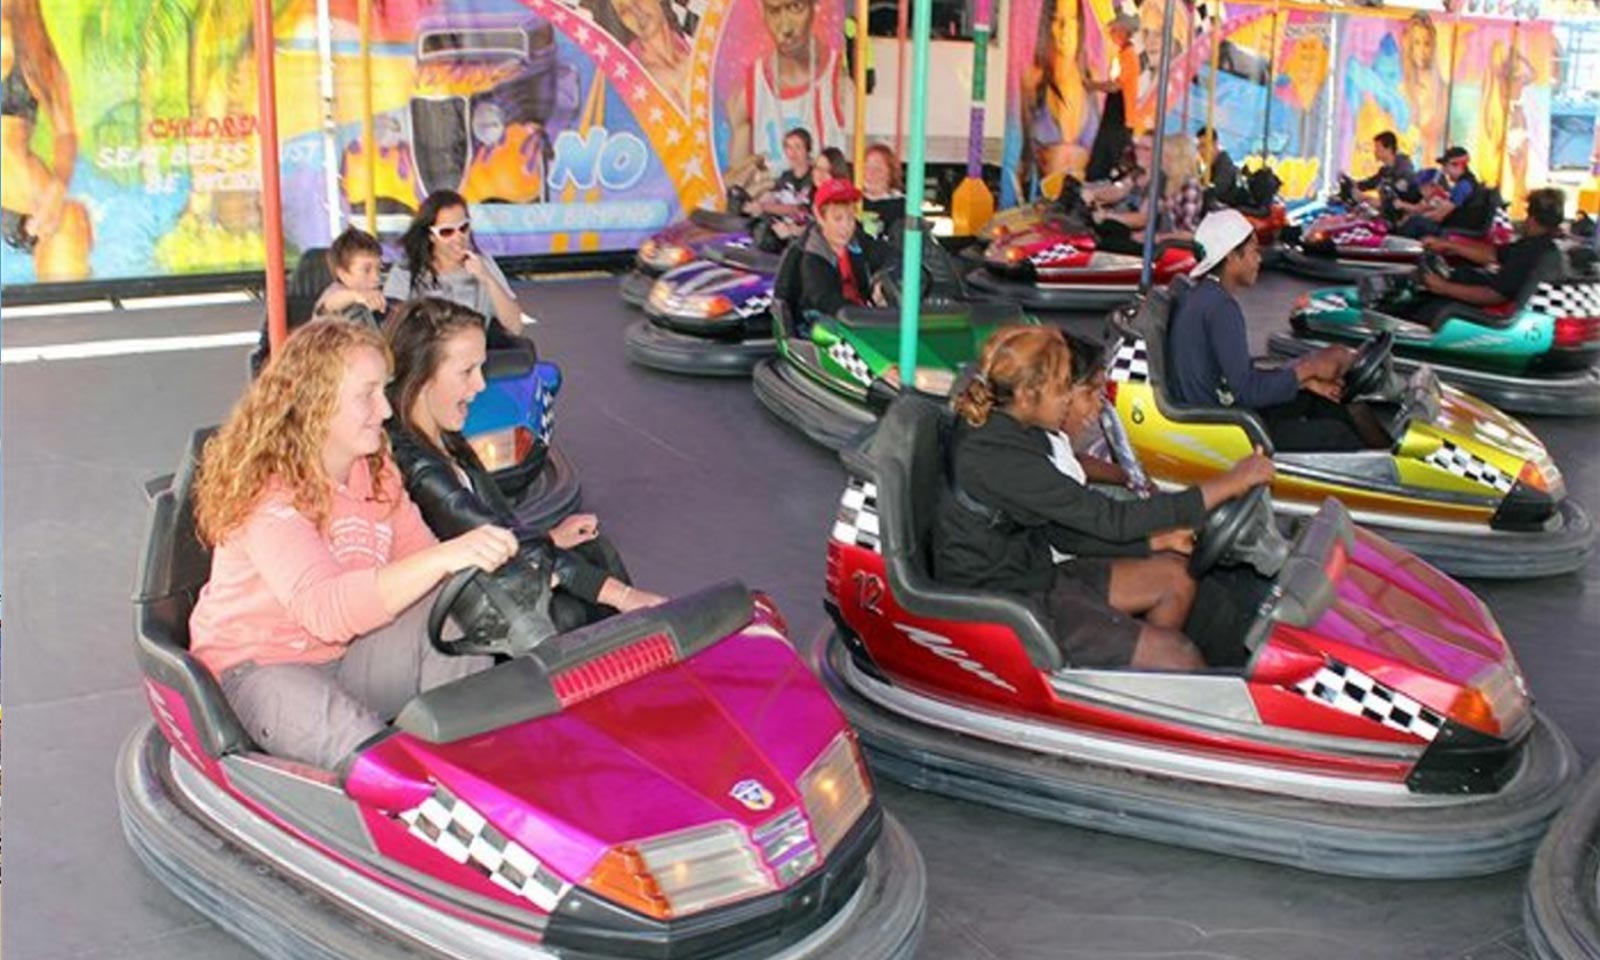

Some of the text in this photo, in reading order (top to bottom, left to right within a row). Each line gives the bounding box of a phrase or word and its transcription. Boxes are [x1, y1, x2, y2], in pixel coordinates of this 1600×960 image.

[149, 117, 261, 139] CHILDREN
[96, 144, 162, 169] SEAT
[547, 126, 648, 190] NO
[852, 570, 885, 615] 12
